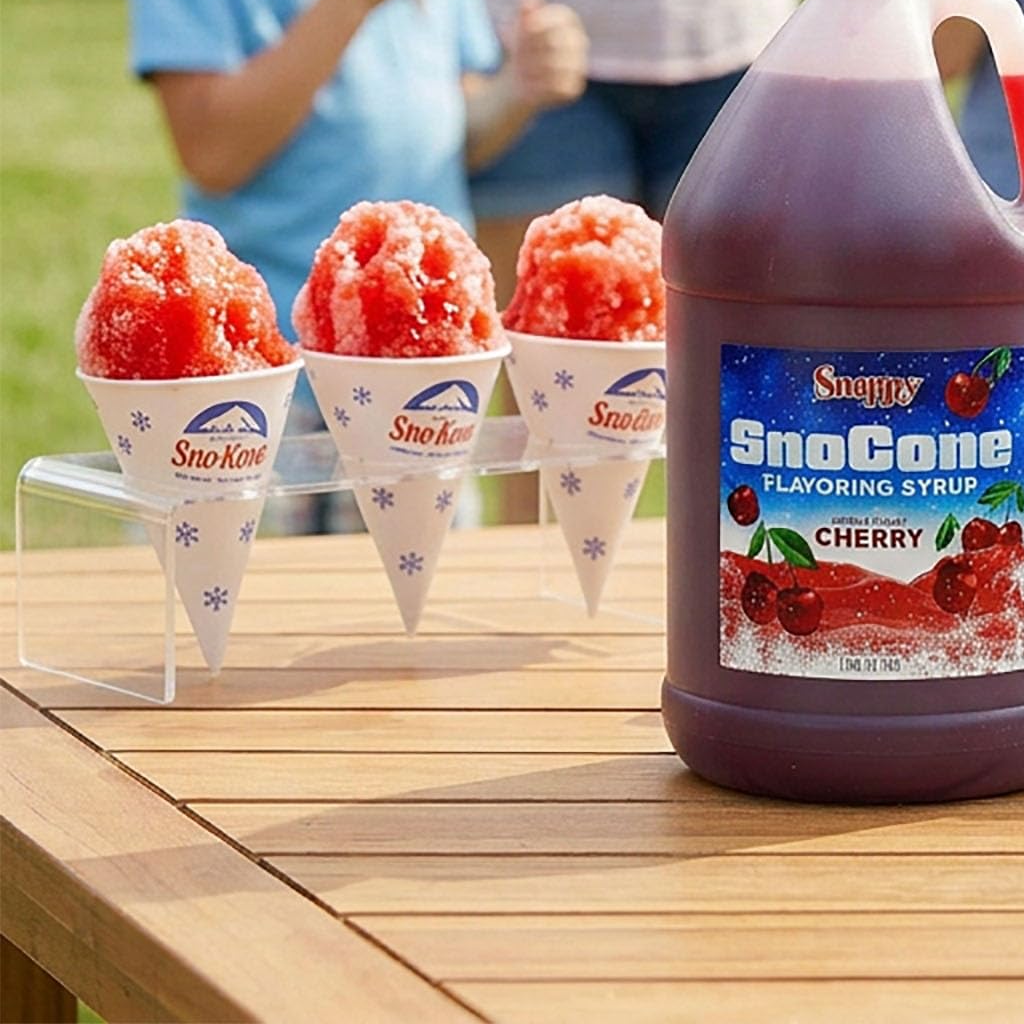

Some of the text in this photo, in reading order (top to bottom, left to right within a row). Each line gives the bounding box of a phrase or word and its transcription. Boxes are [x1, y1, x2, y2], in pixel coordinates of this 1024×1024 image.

[813, 364, 924, 408] Snappy
[730, 418, 1012, 472] SnoCone
[901, 477, 977, 496] SYRUP
[815, 527, 923, 548] CHERRY
